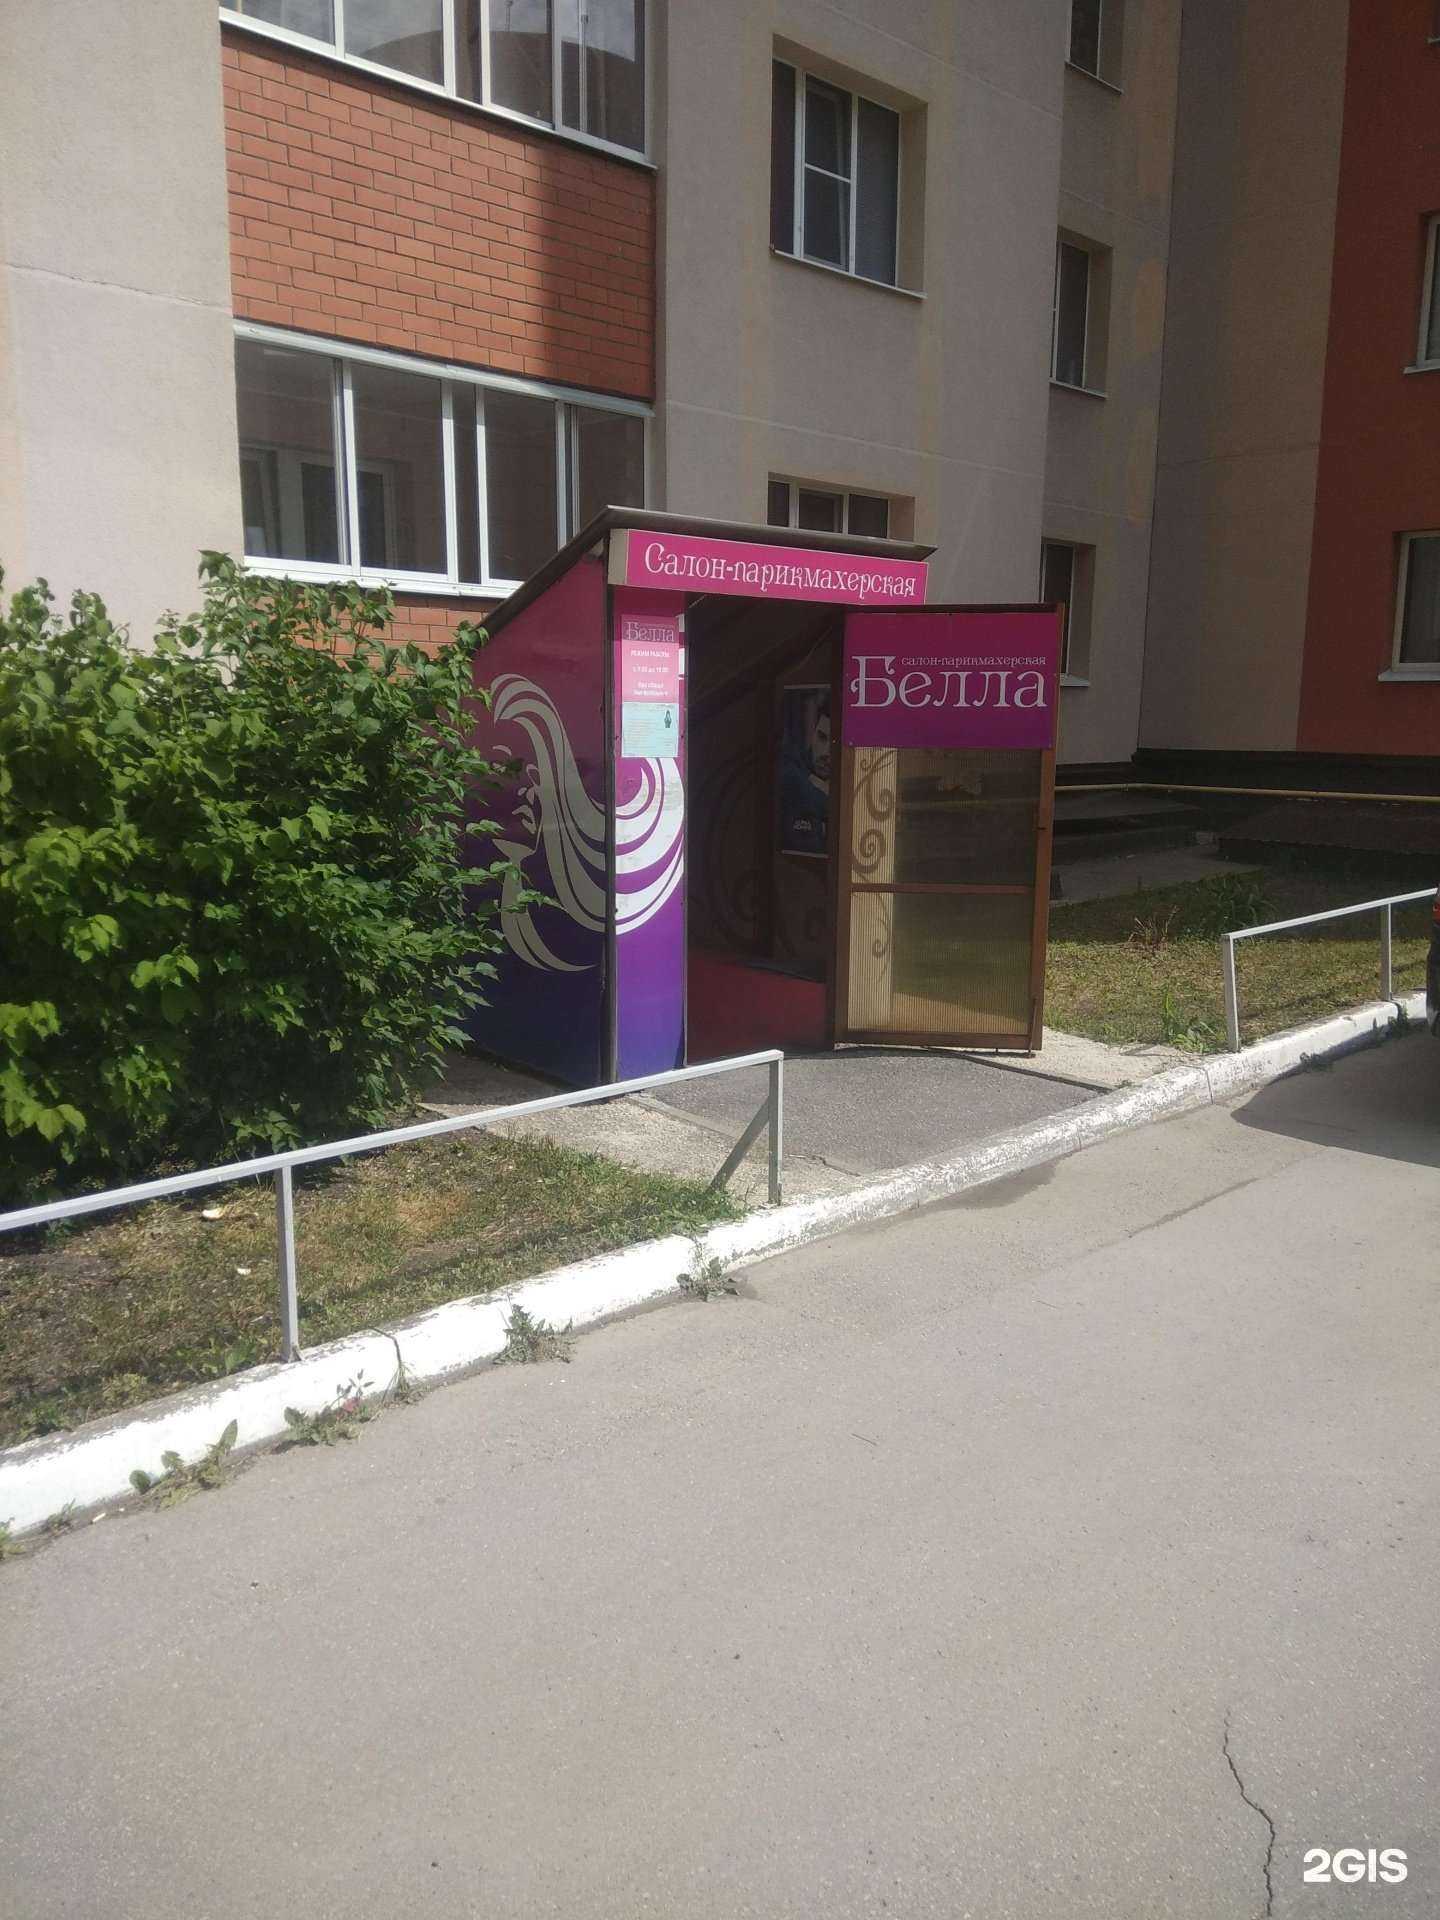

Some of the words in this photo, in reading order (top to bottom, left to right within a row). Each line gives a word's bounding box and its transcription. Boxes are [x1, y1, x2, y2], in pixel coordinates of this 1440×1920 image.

[645, 542, 917, 599] Салон-парикмахерская
[624, 621, 675, 642] Белла
[902, 656, 1047, 668] салон-парикмахерская
[850, 656, 1048, 708] Белла
